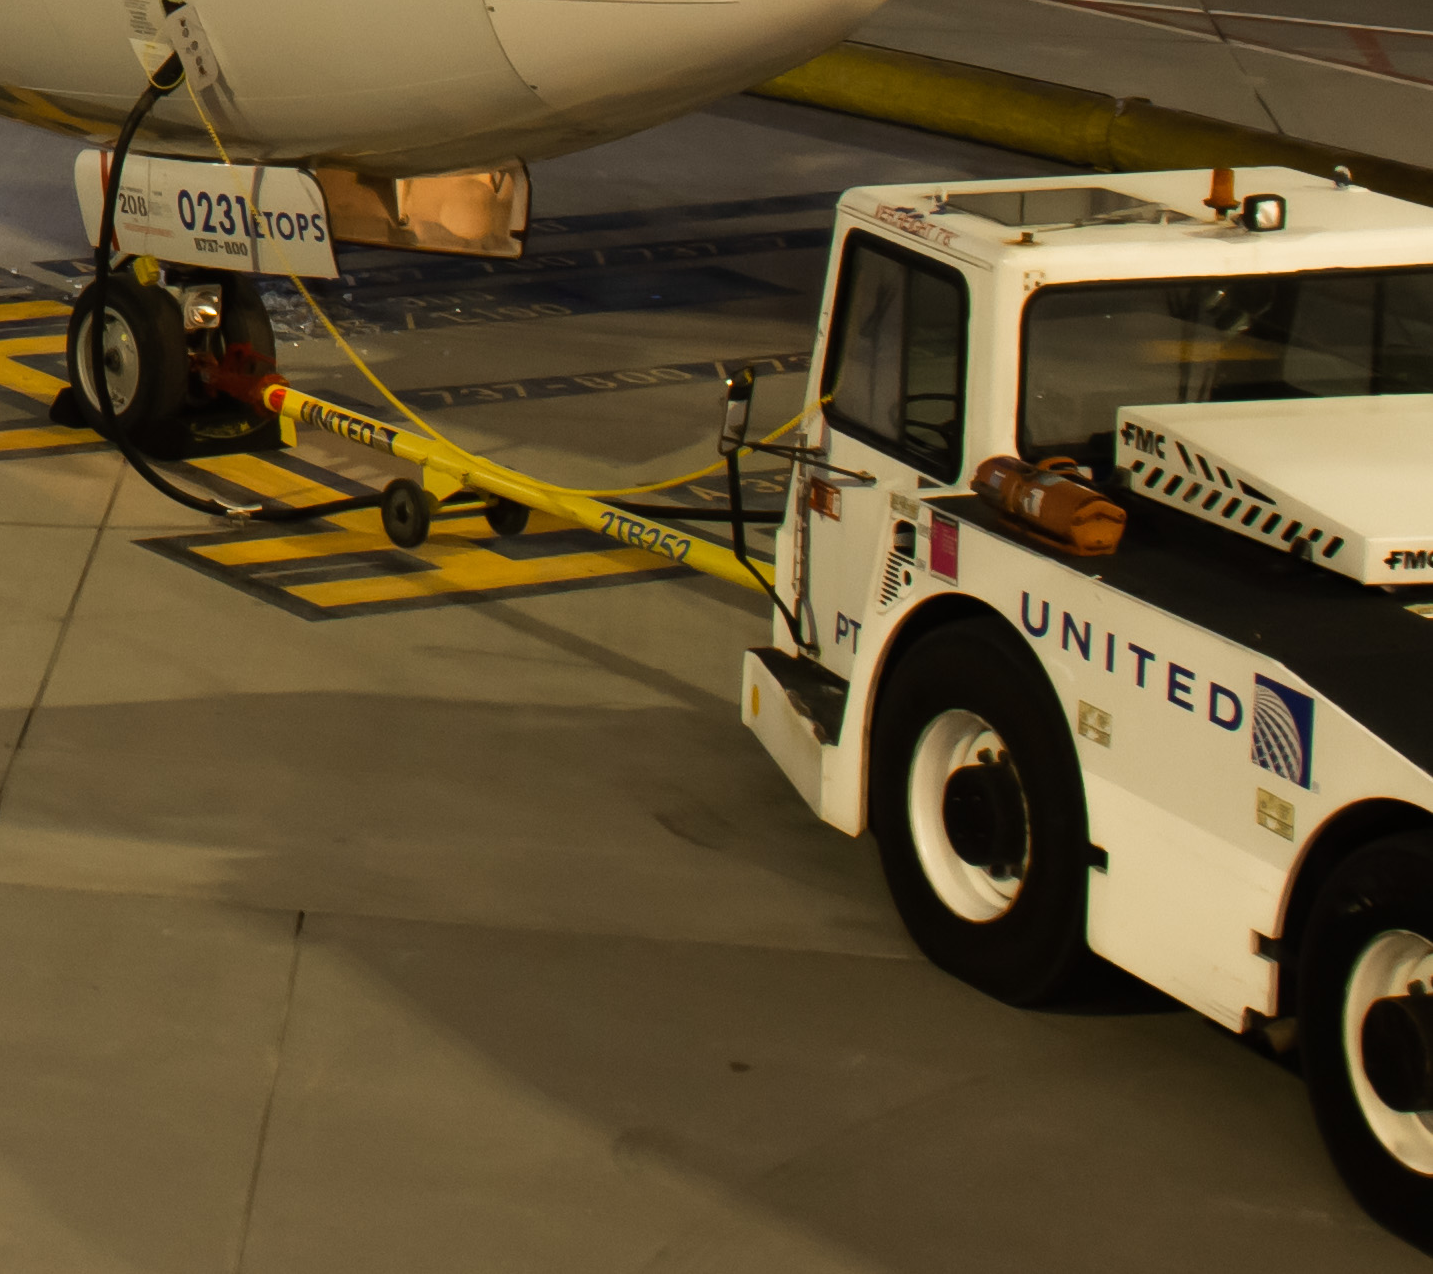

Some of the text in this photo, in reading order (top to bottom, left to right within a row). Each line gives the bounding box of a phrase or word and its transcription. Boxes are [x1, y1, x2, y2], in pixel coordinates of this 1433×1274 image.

[118, 193, 148, 217] 208
[177, 189, 251, 237] 0231
[252, 211, 325, 243] ETOPS
[419, 367, 695, 406] 737-800
[300, 400, 376, 448] UNITED
[1121, 421, 1166, 460] FMC
[600, 511, 691, 563] 2TB252
[1021, 590, 1244, 732] UNITED
